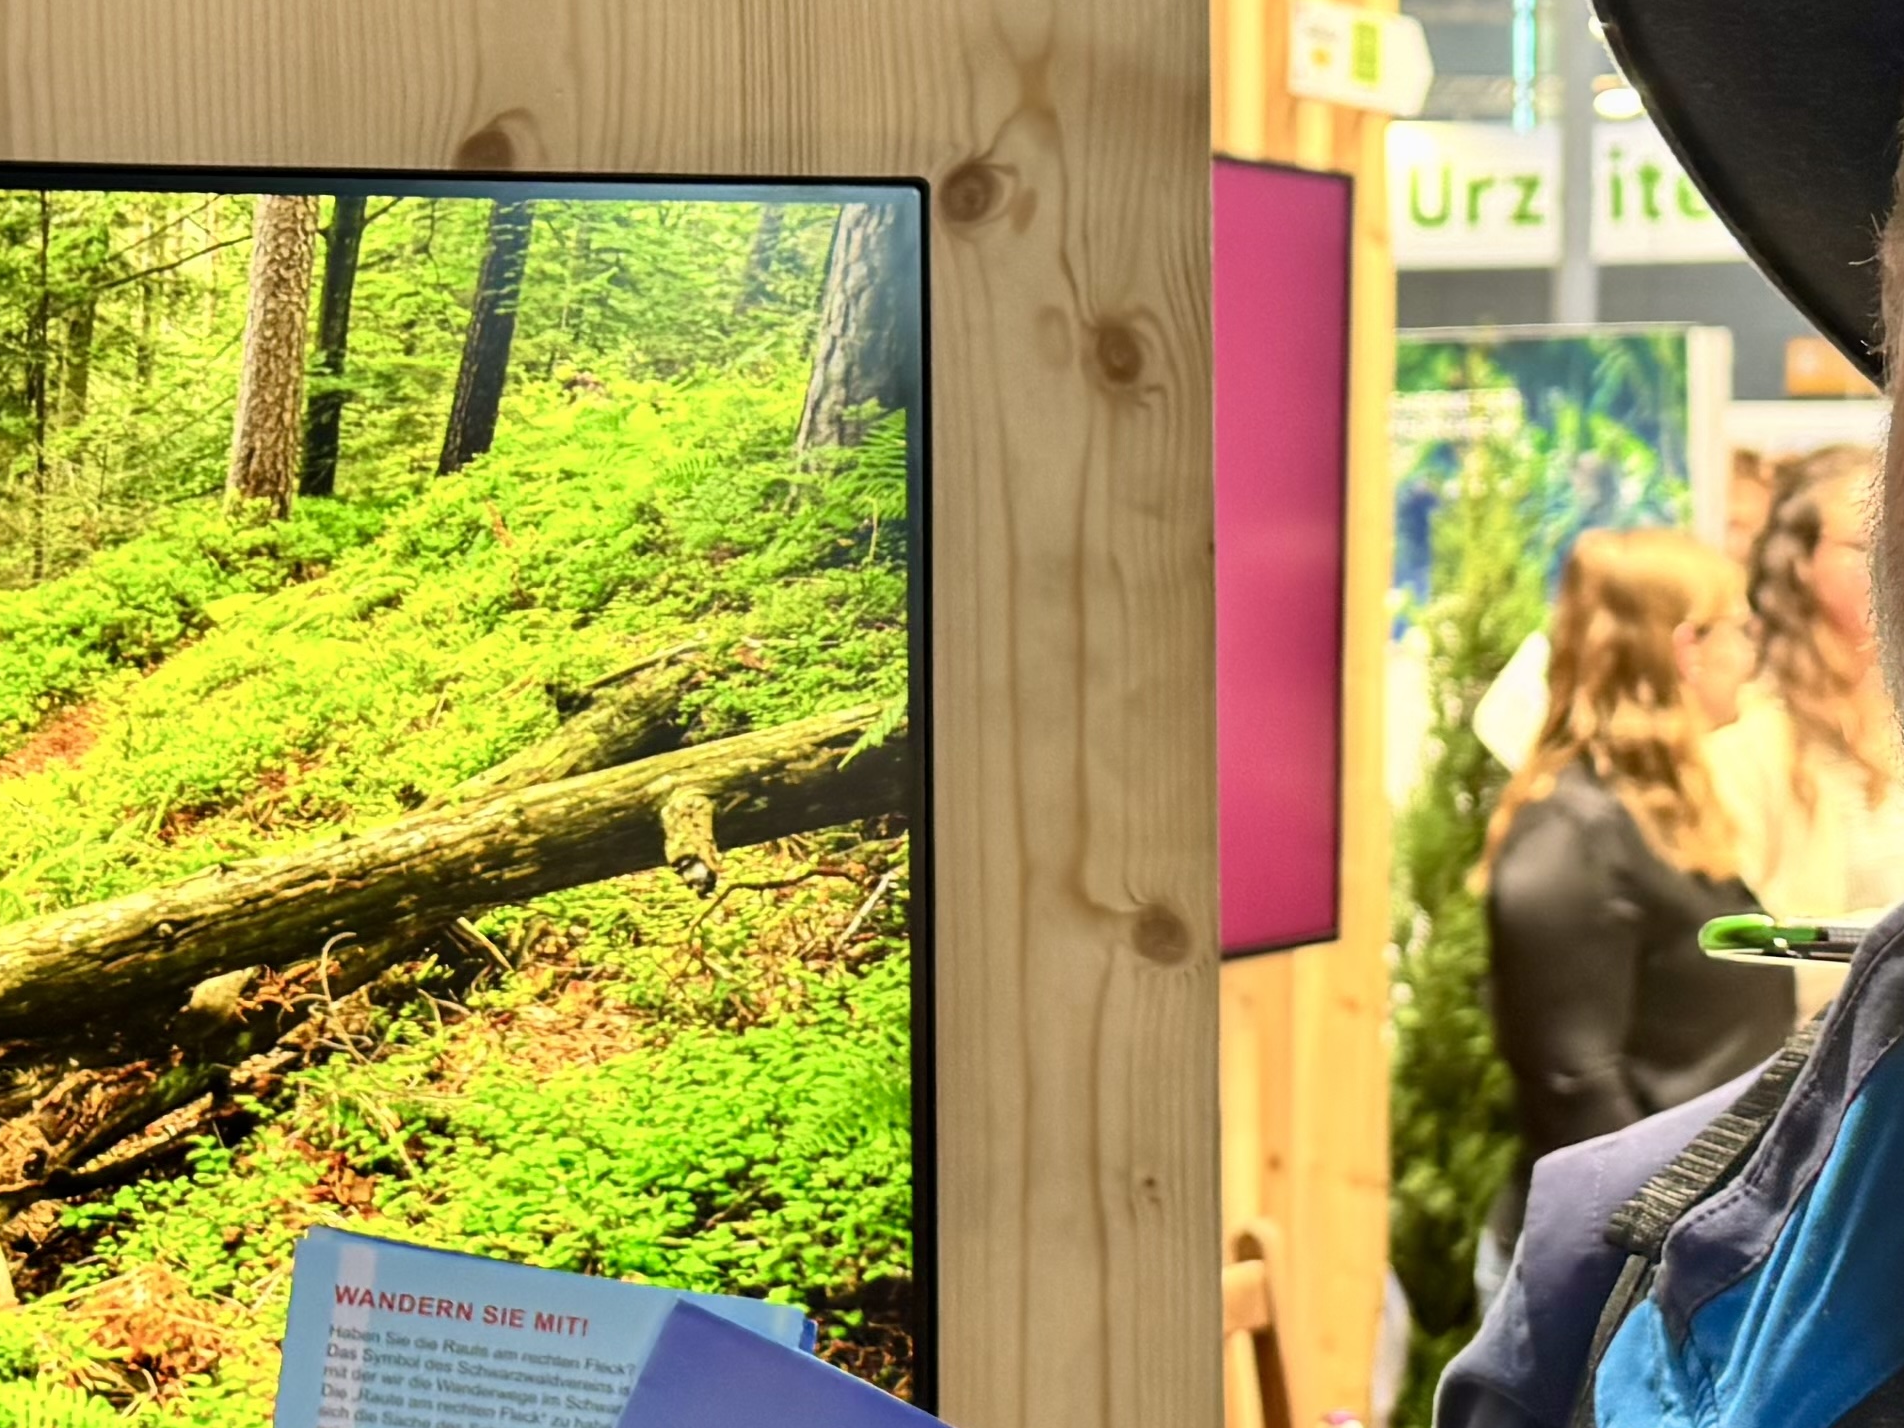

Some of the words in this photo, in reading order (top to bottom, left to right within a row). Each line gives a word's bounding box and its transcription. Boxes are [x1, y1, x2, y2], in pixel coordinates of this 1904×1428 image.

[333, 1283, 474, 1321] WANDERN
[481, 1303, 525, 1327] SIE
[533, 1311, 588, 1337] MIT!
